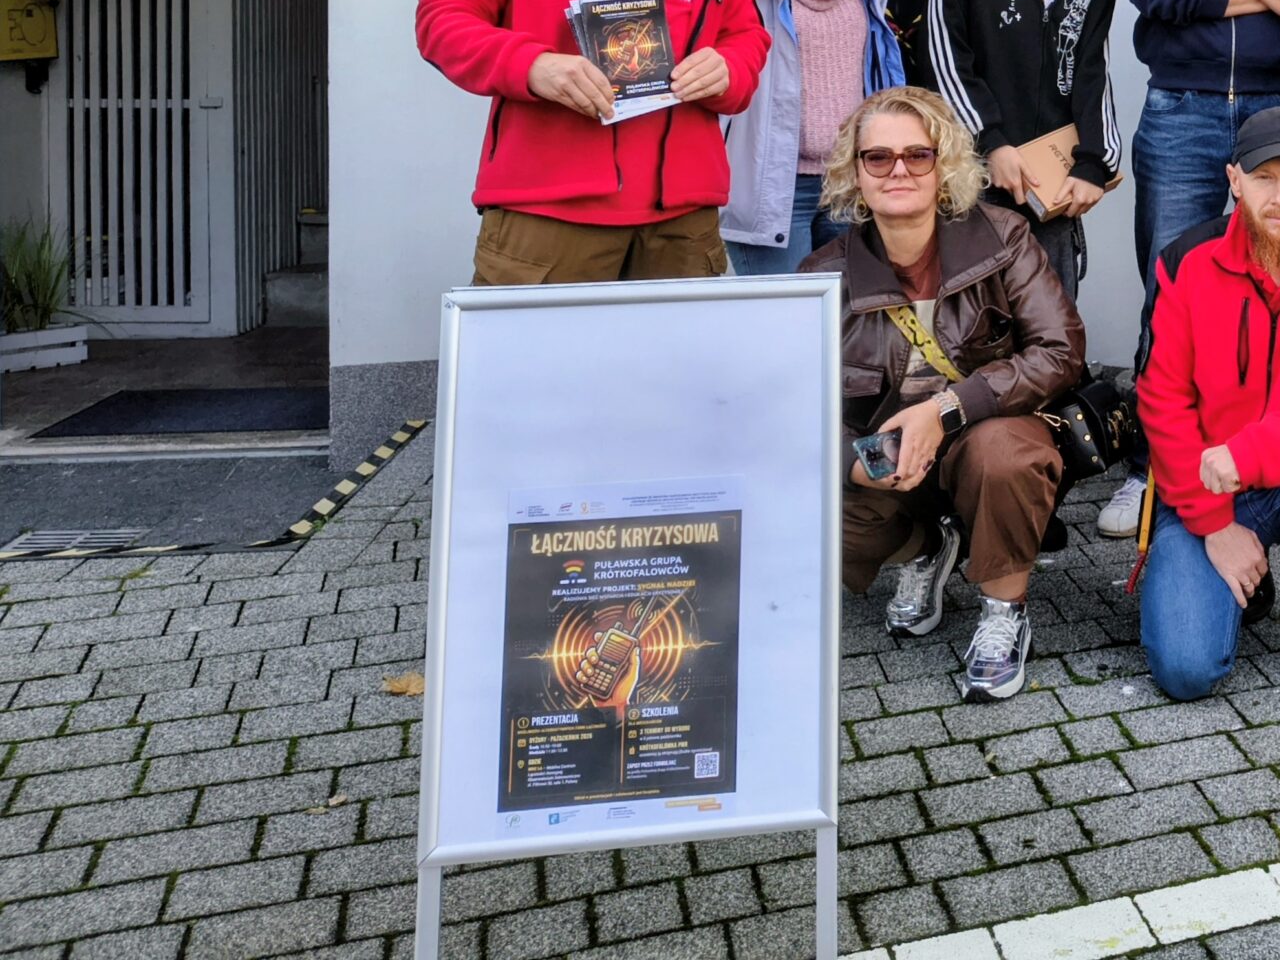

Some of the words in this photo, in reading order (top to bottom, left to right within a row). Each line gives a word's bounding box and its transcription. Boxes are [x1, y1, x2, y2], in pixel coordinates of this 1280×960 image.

[1048, 142, 1072, 170] RETE
[530, 525, 617, 556] ŁĄCZNOŚĆ
[621, 522, 720, 549] KRYZYSOWA
[593, 558, 649, 570] PUŁAWSKA
[650, 556, 683, 567] GRUPA
[593, 563, 690, 580] KRÓTKOFALOWCÓW
[551, 586, 601, 596] REALIZUJEMY
[641, 705, 679, 719] SZKOLENIA
[531, 714, 579, 727] PREZENTACJA
